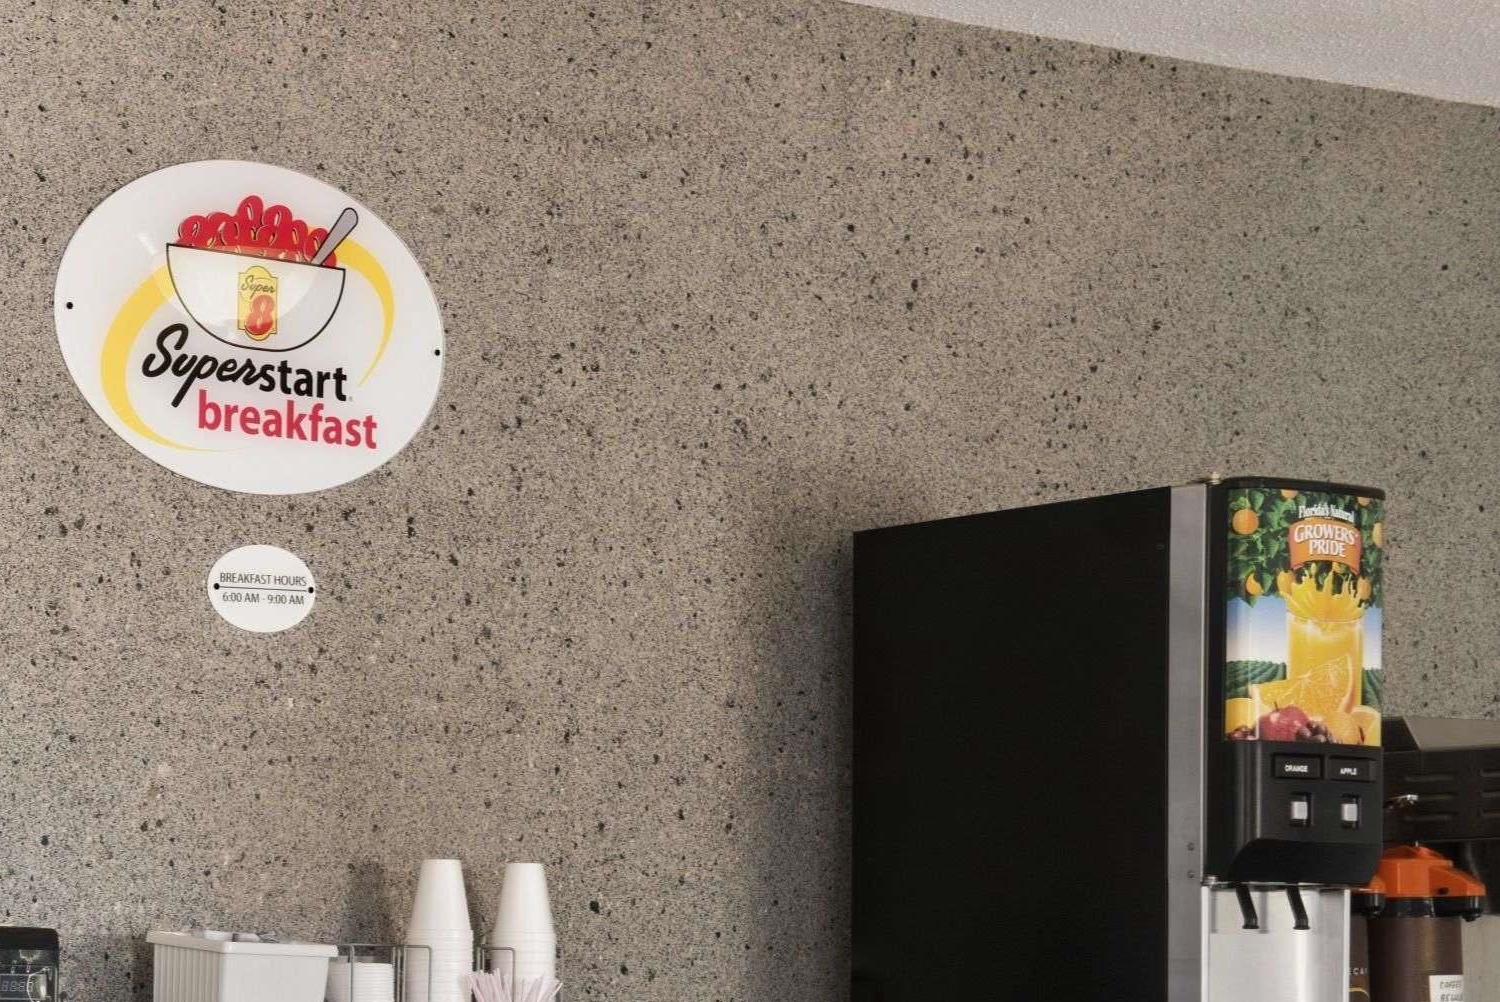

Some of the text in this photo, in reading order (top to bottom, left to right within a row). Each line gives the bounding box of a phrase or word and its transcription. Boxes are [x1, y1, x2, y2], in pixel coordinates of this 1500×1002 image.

[241, 275, 276, 300] Super
[245, 294, 275, 336] 8
[142, 322, 348, 408] Superstart
[198, 389, 378, 449] breakfast
[1309, 540, 1347, 558] PRIDE
[220, 572, 307, 587] BREAKFAST HOURS
[222, 592, 242, 603] 6:00
[244, 593, 260, 603] AM
[267, 594, 287, 605] 9:00
[288, 595, 305, 605] AM
[1284, 765, 1308, 773] ORANGE
